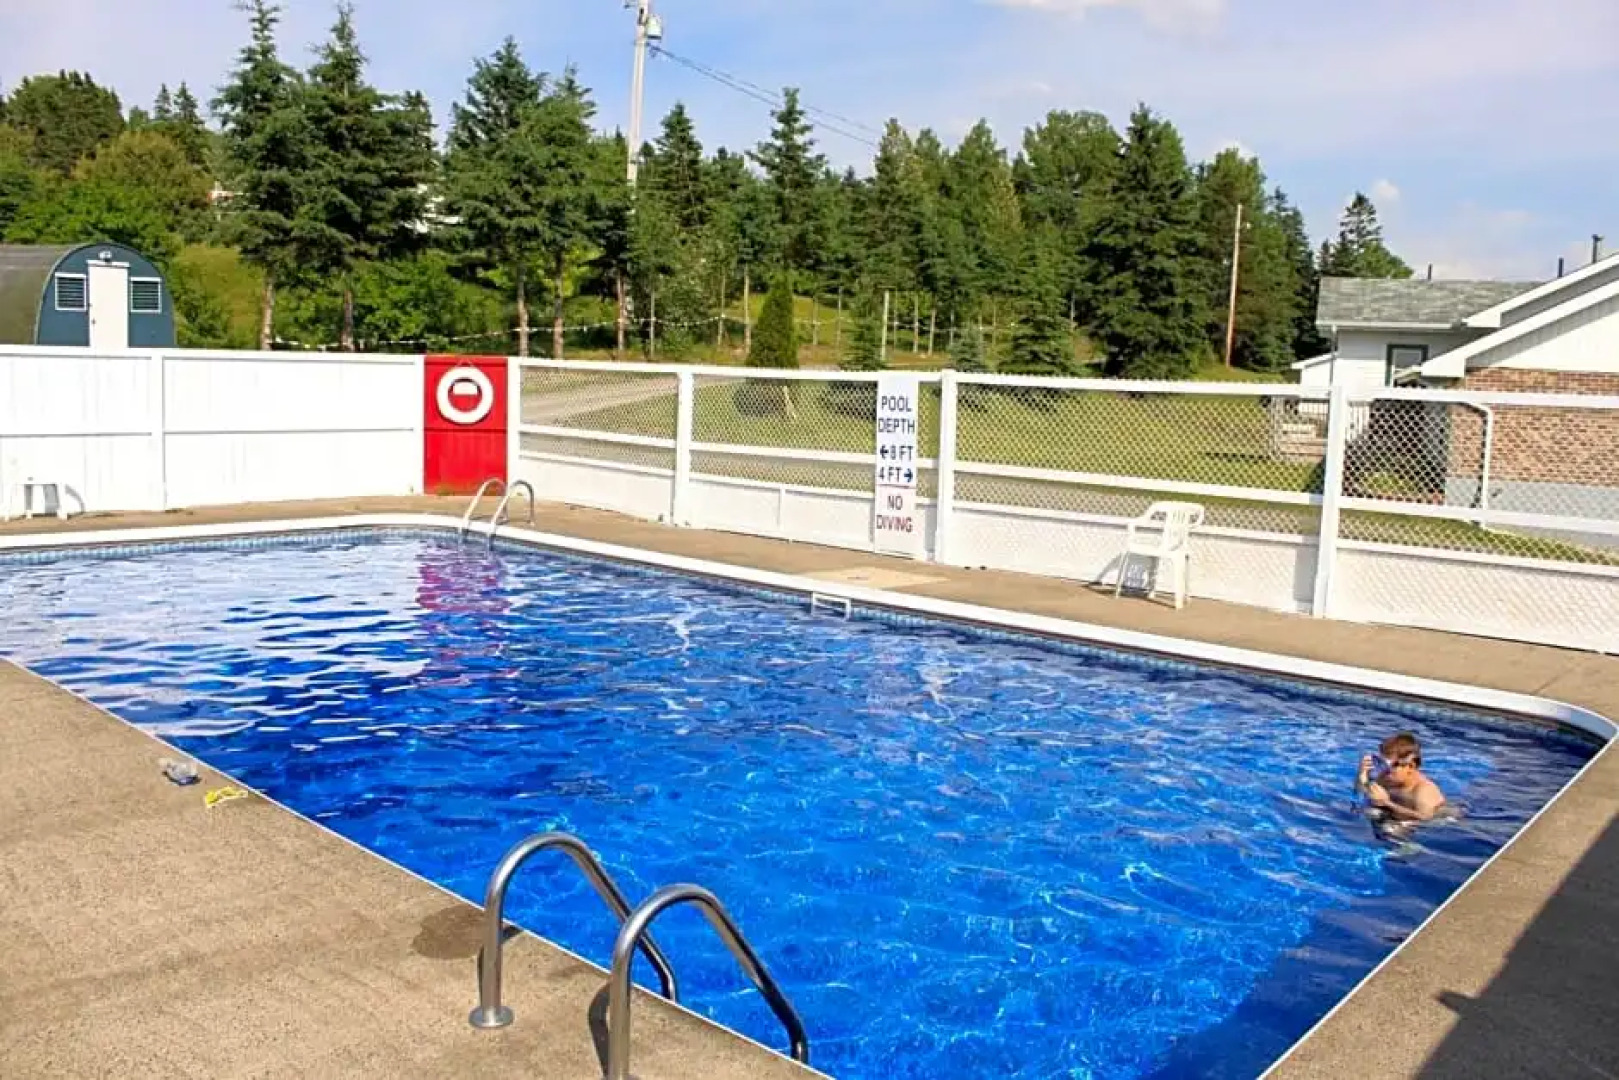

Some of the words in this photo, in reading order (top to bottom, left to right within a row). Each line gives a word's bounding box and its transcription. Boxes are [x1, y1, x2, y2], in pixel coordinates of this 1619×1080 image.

[881, 395, 912, 412] POOL
[878, 418, 915, 433] DEPTH
[899, 445, 914, 461] FT
[879, 466, 885, 480] 4
[888, 466, 902, 482] FT
[887, 495, 903, 511] NO
[876, 515, 913, 533] DIVING
